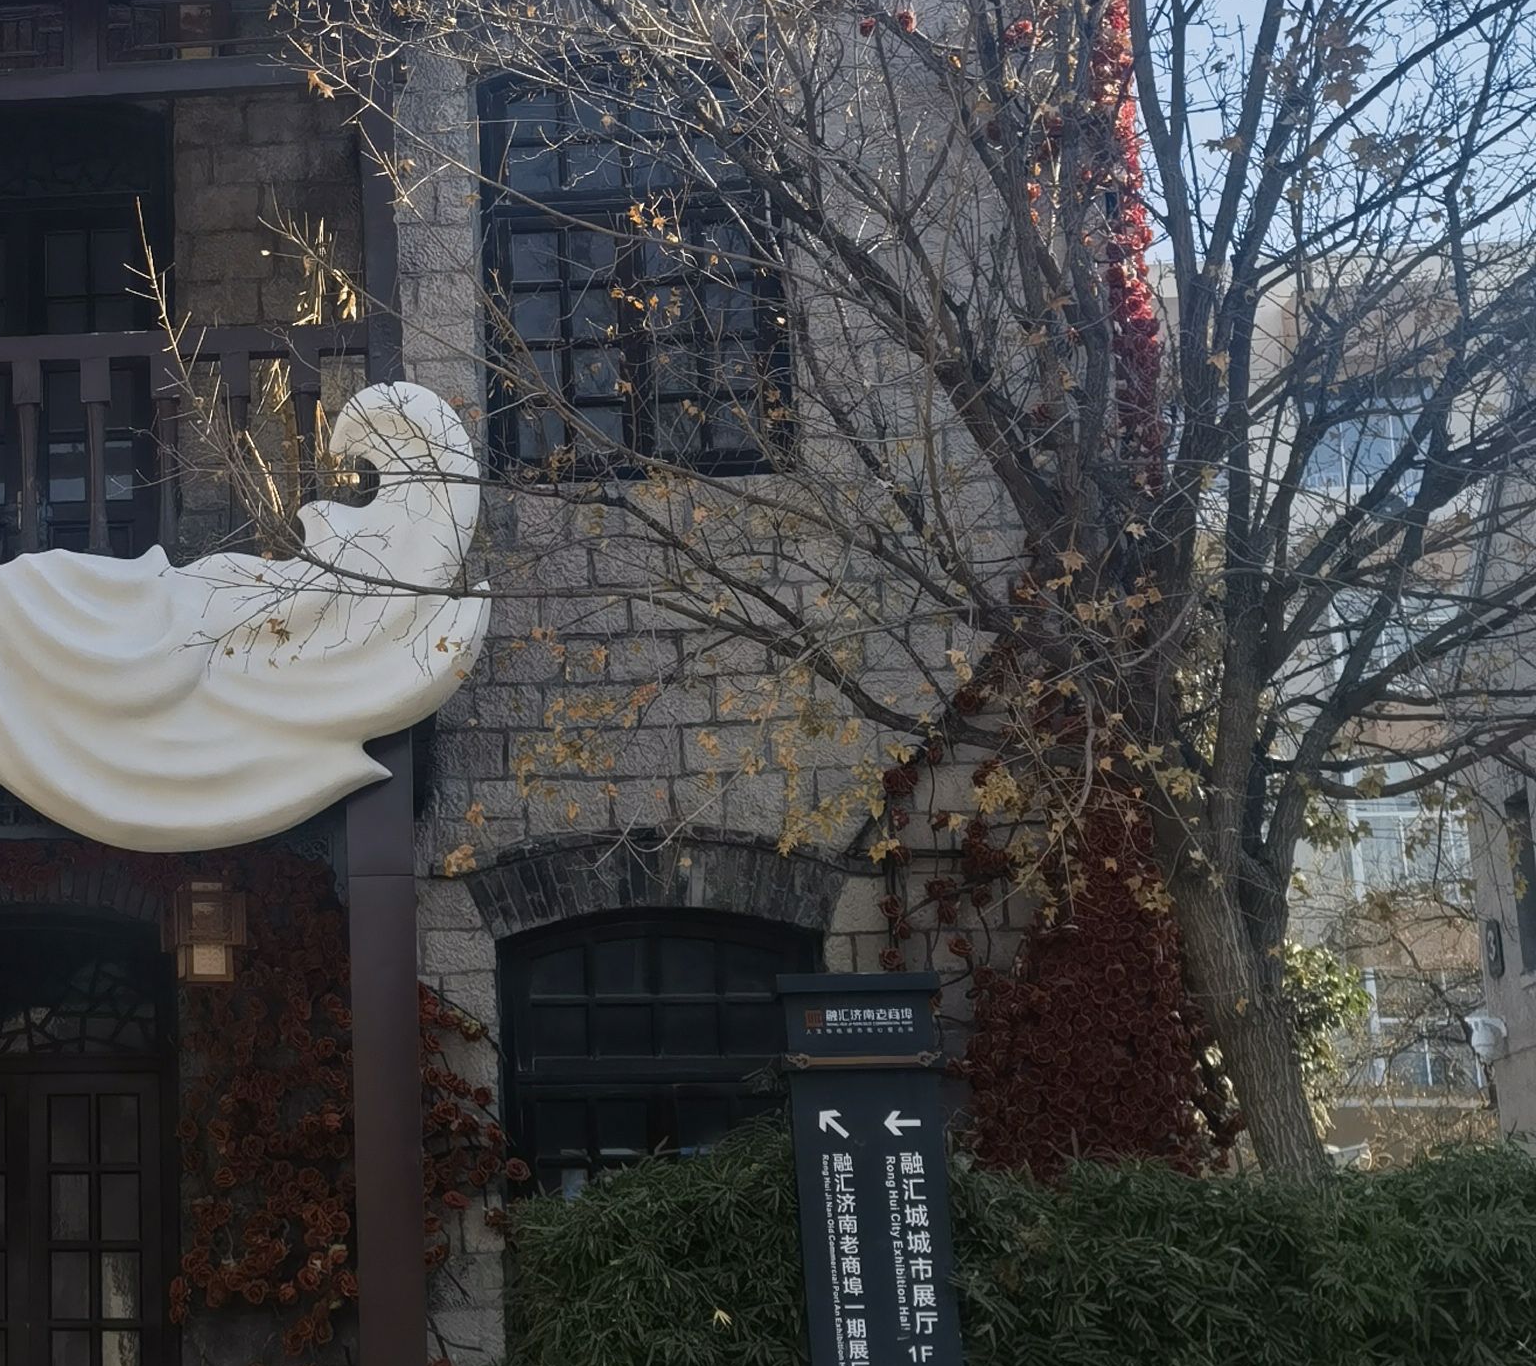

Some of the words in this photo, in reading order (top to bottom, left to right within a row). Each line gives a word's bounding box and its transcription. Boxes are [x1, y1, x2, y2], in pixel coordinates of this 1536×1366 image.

[822, 1154, 830, 1176] Rong
[885, 1155, 896, 1187] Rong
[824, 1177, 832, 1191] Hui
[889, 1190, 900, 1211] Hui
[827, 1218, 835, 1234] Old
[890, 1213, 902, 1238] City
[899, 1152, 939, 1335] 融汇城城市展厅
[893, 1241, 907, 1304] Exhibition
[831, 1285, 840, 1304] Port
[835, 1317, 845, 1361] Exhibition
[908, 1346, 934, 1363] 1F
